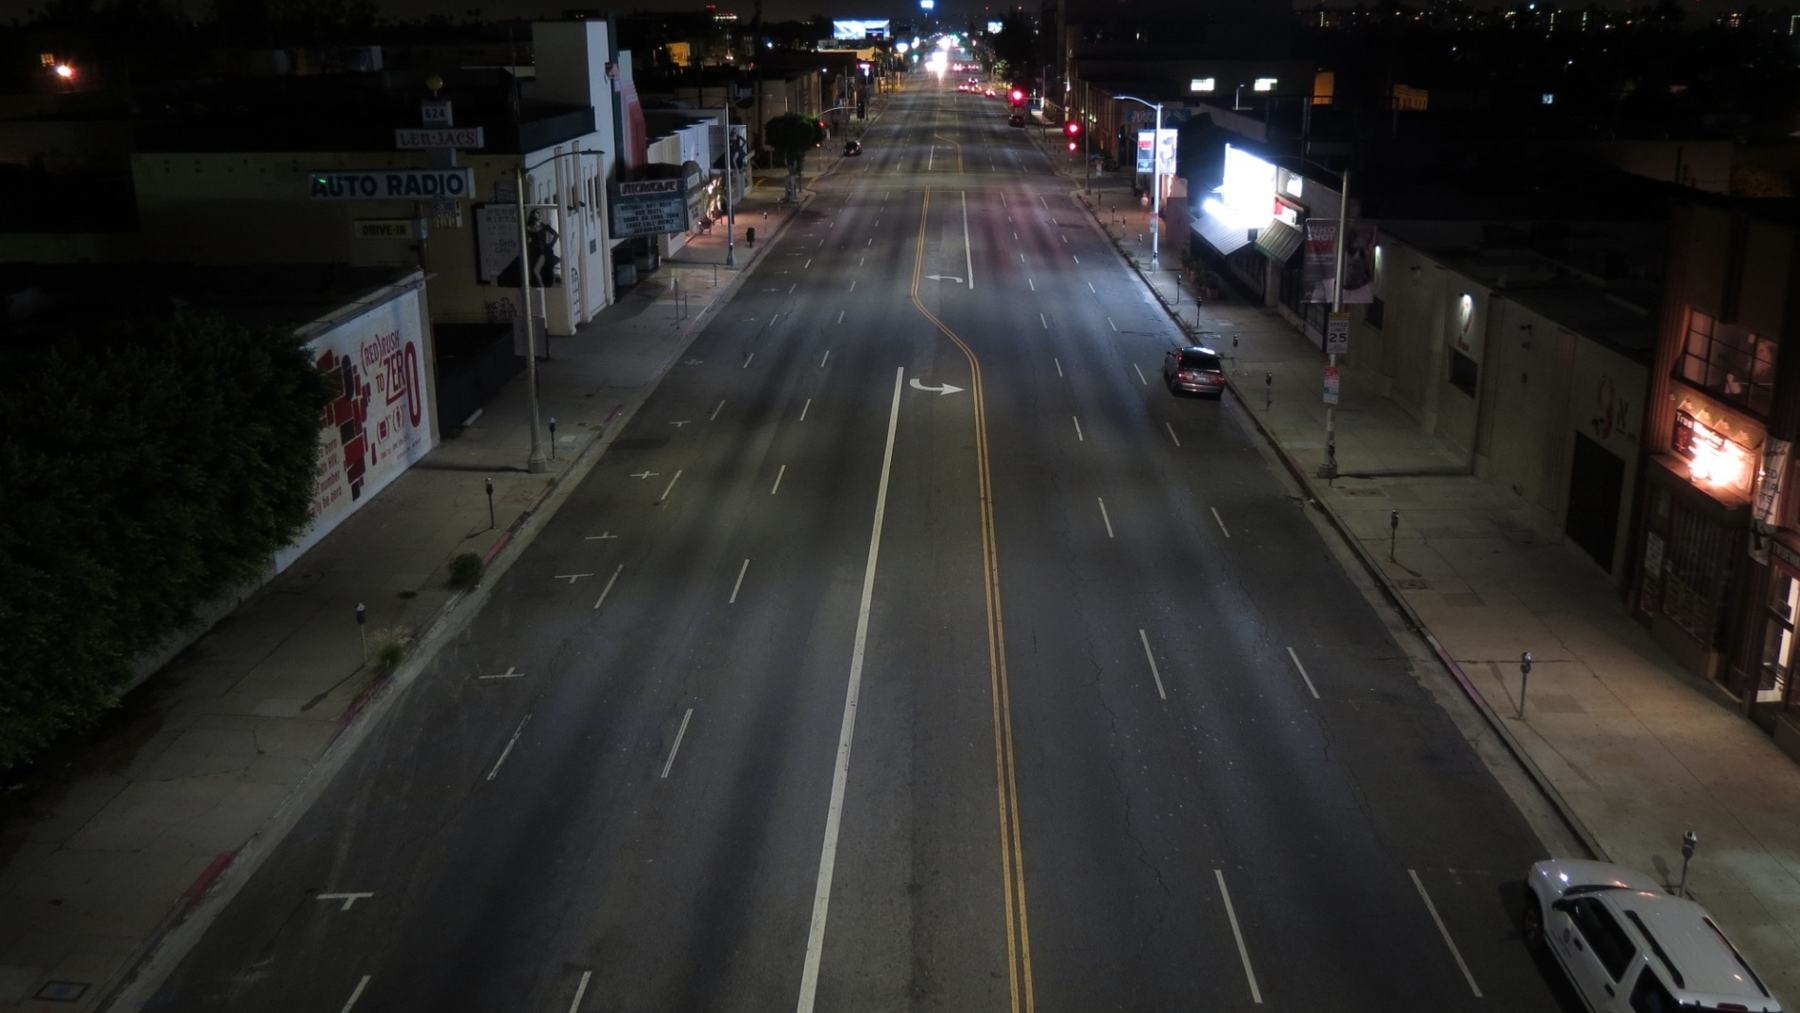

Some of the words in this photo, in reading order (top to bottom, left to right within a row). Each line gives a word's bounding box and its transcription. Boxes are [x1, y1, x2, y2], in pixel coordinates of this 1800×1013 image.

[425, 106, 445, 118] 624
[311, 174, 377, 198] AUTO
[386, 173, 464, 196] RADIO
[361, 224, 407, 235] DRIVE-IN
[1329, 333, 1347, 343] 25
[375, 373, 385, 394] TO
[383, 340, 422, 428] ZERO
